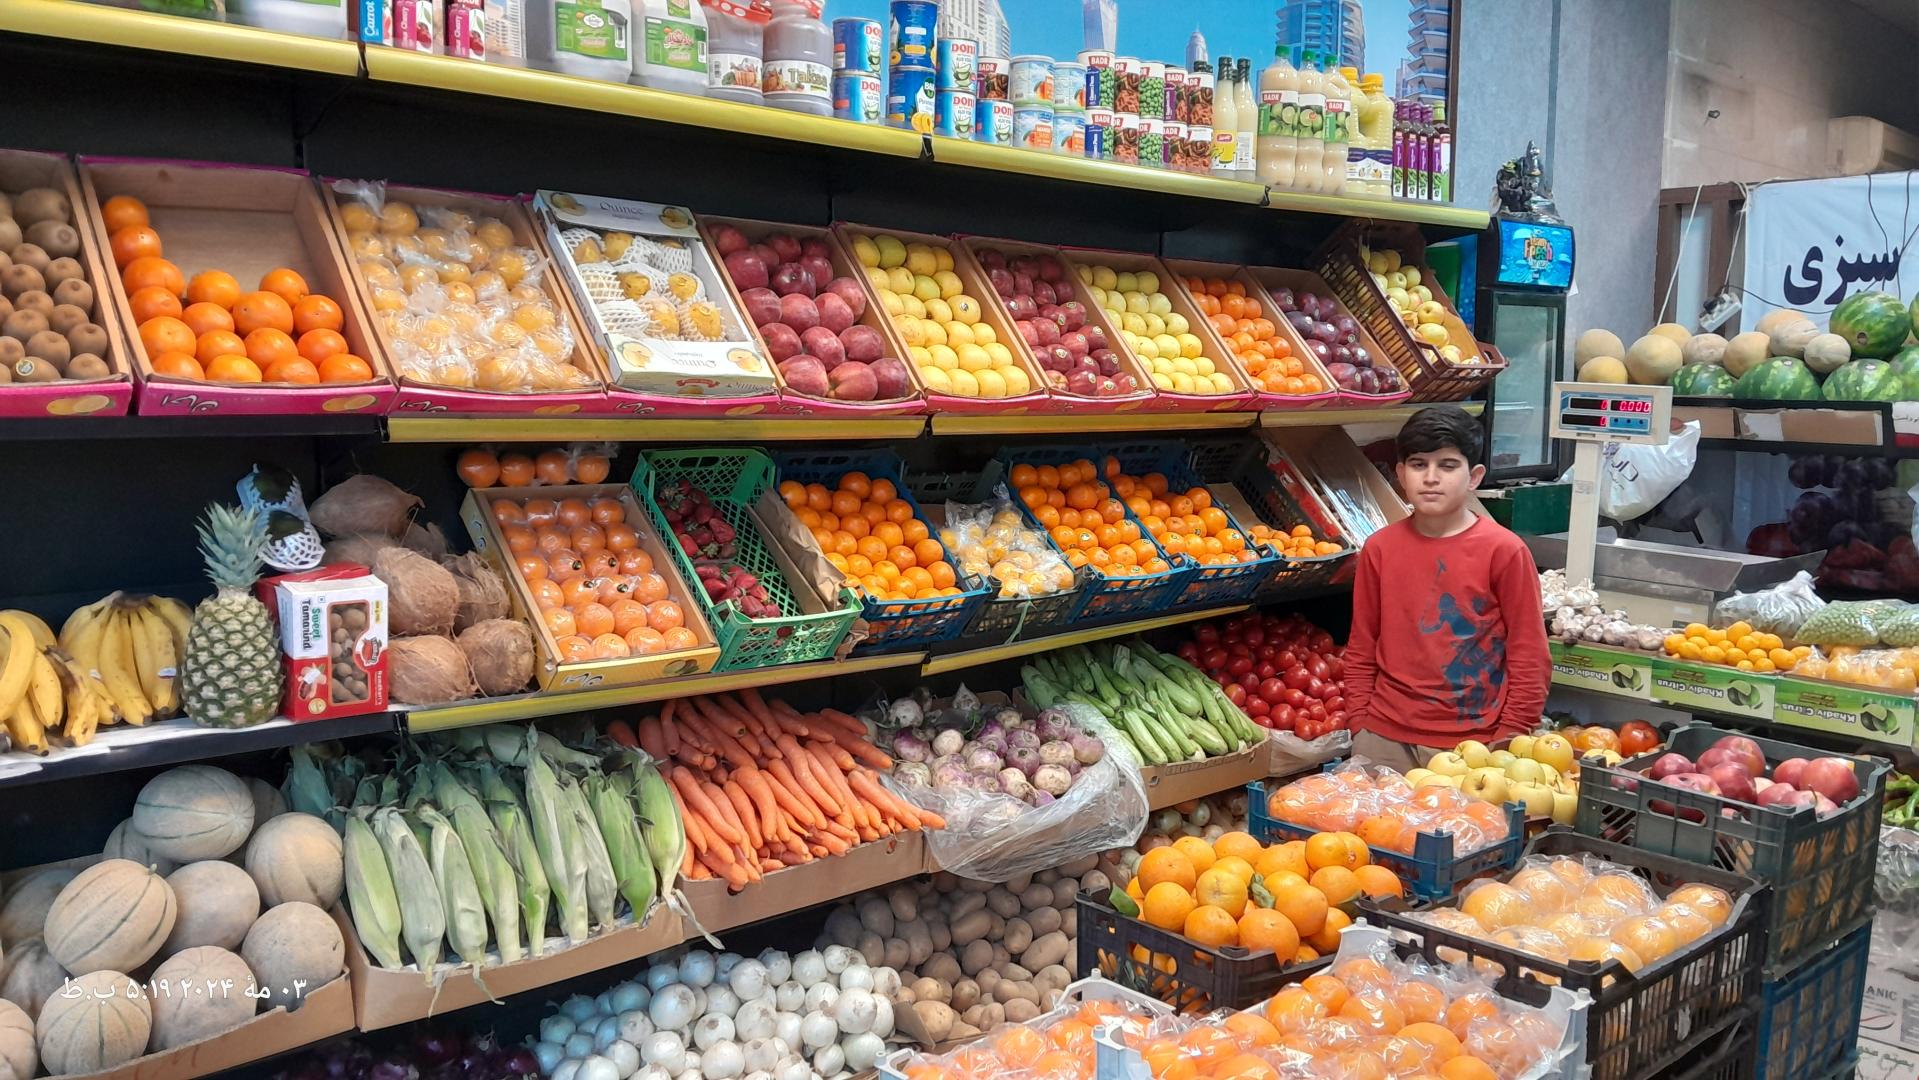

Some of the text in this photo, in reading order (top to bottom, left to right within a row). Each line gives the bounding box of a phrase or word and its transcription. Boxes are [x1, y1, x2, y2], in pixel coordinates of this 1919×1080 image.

[365, 0, 376, 36] Carrot
[1091, 57, 1108, 66] BADR
[1094, 115, 1110, 123] BADR
[599, 201, 645, 215] Quince
[1783, 234, 1901, 305] سبزی
[1601, 399, 1652, 413] 0 0.000
[1600, 416, 1608, 427] 0
[302, 599, 312, 649] Tamarind
[312, 607, 322, 640] Sweet
[1553, 664, 1609, 682] Khadiv Citru
[1657, 679, 1724, 698] Khadiv Citrus
[1781, 703, 1857, 724] Khadiv Ctrus
[1865, 985, 1898, 1001] ANIC
